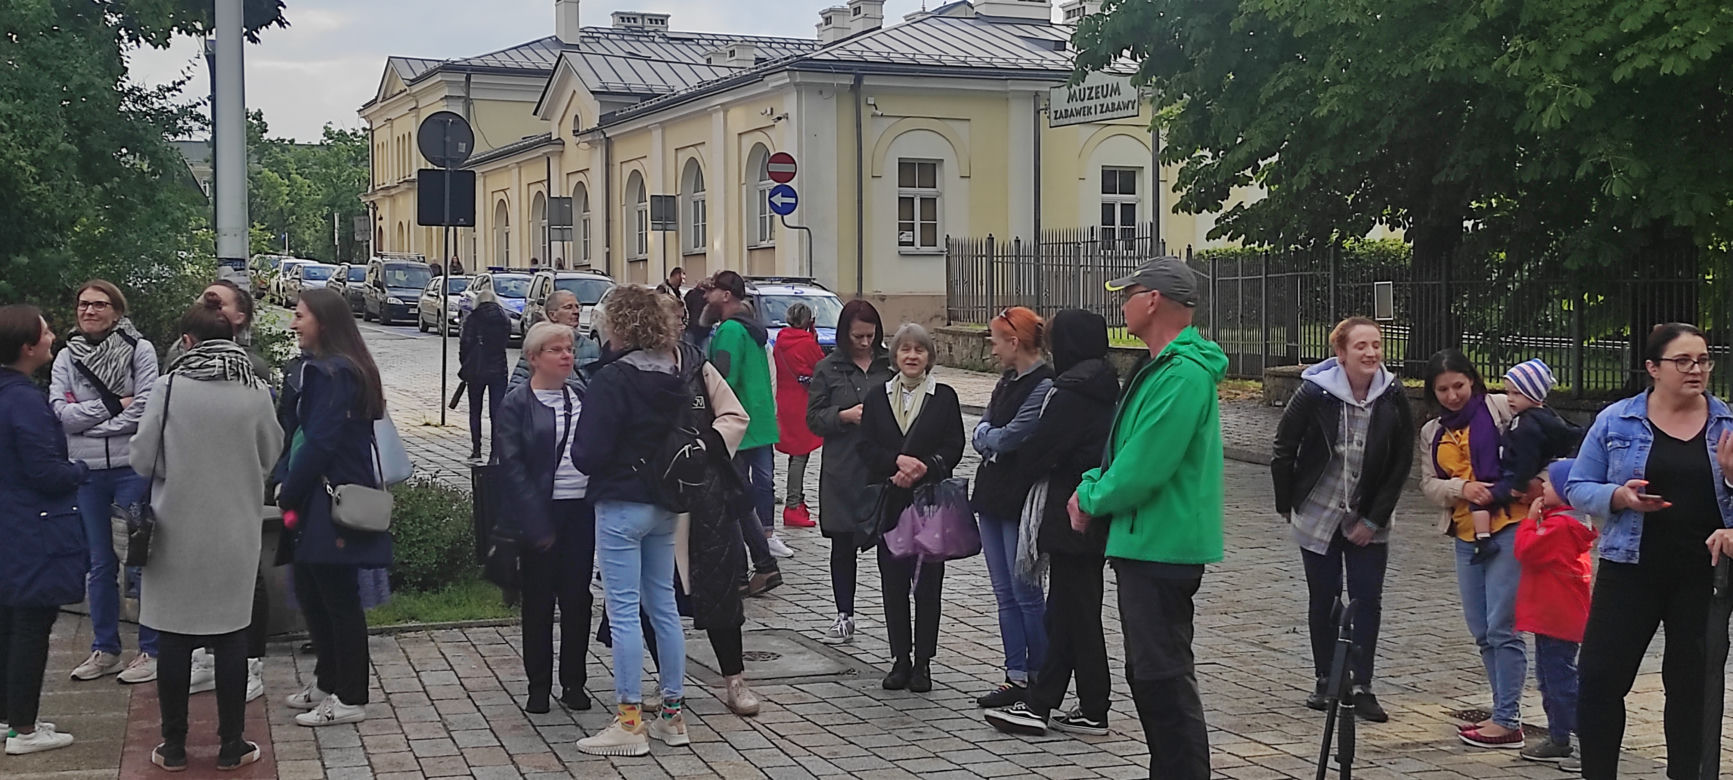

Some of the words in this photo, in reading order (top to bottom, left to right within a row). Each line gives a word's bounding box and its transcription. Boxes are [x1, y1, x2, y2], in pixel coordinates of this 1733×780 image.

[1067, 81, 1121, 103] MUZEUM
[1053, 105, 1092, 120] ZABAWEK
[1094, 104, 1098, 115] I
[1099, 99, 1136, 114] ZABAWY
